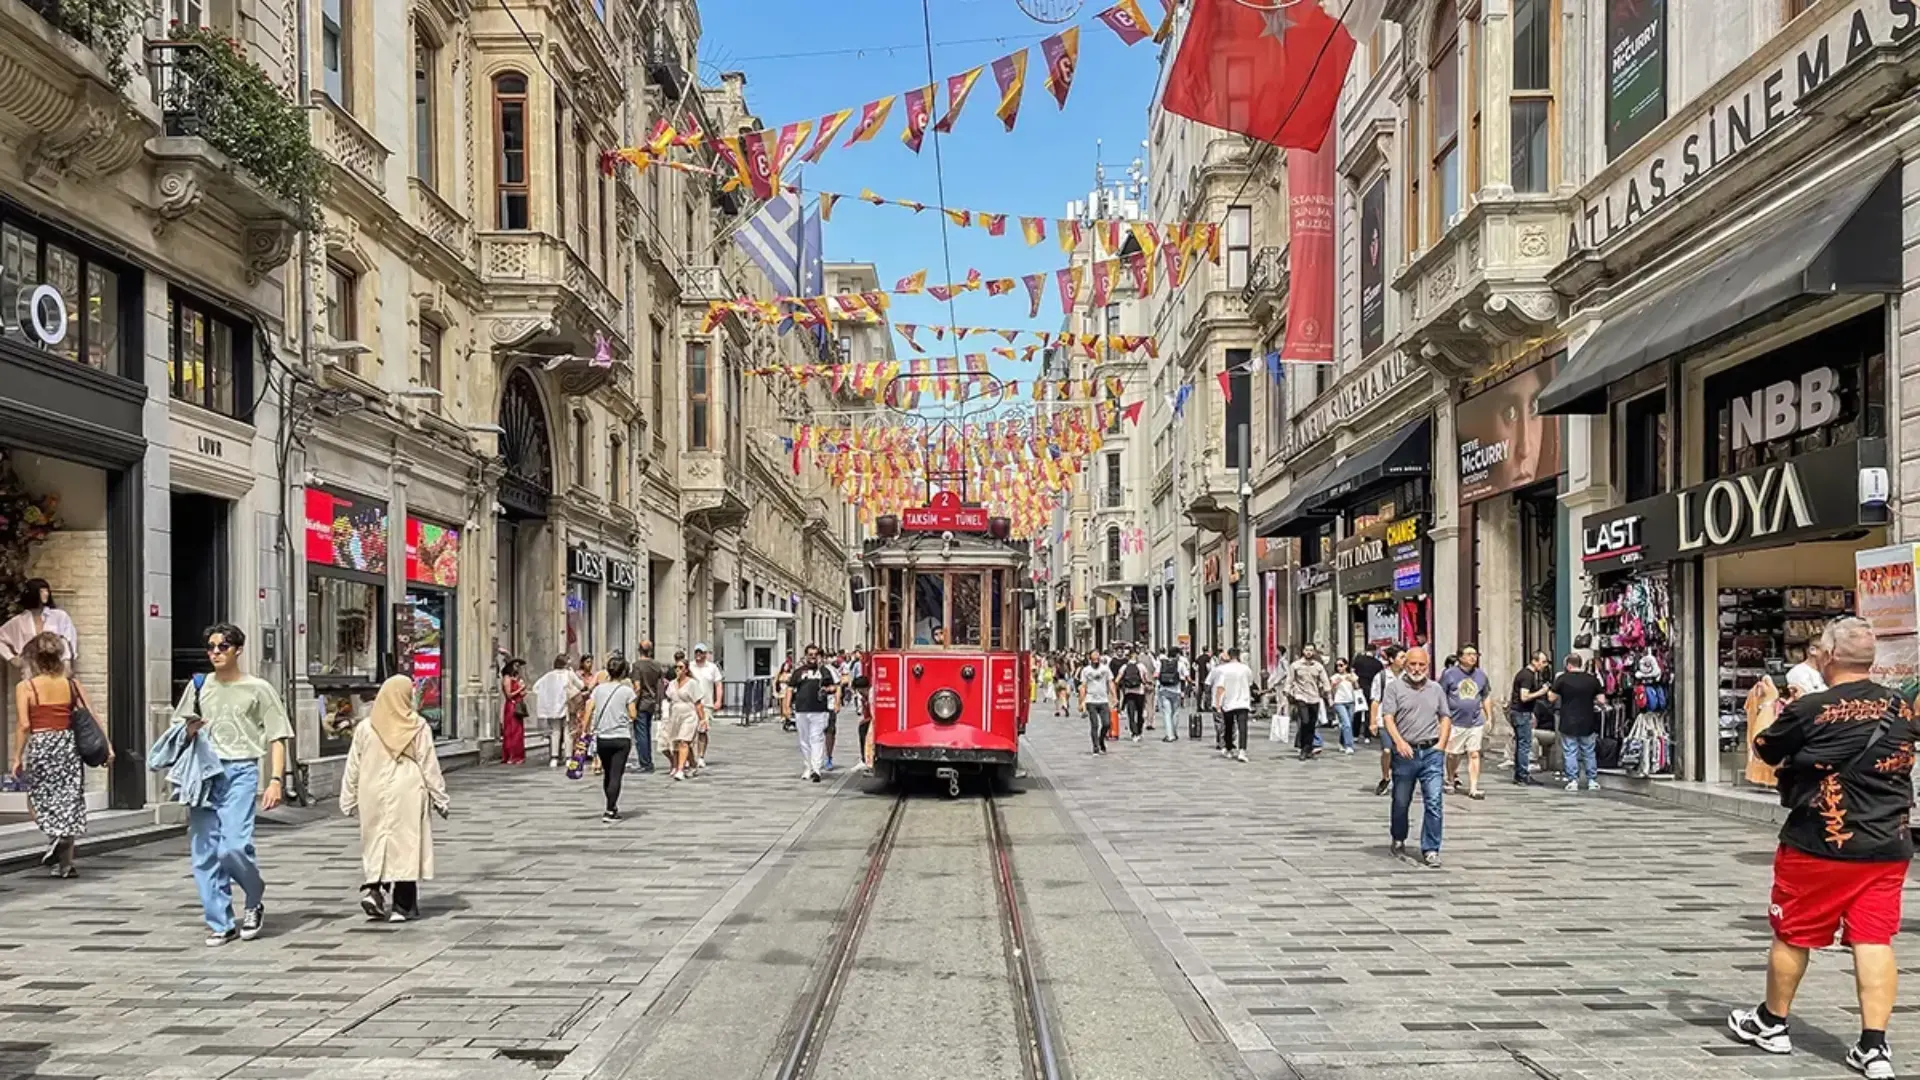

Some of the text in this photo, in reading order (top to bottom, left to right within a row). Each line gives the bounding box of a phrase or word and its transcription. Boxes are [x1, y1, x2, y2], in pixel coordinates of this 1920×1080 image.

[1567, 158, 1668, 258] ATLAS
[1732, 366, 1840, 450] NBB
[1461, 437, 1480, 455] STEVE
[1461, 438, 1510, 475] McCURRY
[906, 511, 939, 526] TAKSİM
[955, 511, 983, 526] TÜNEL
[941, 493, 950, 507] 2
[1677, 462, 1814, 551] LOYA
[1387, 517, 1417, 547] CHANGE
[1583, 515, 1640, 555] LAST
